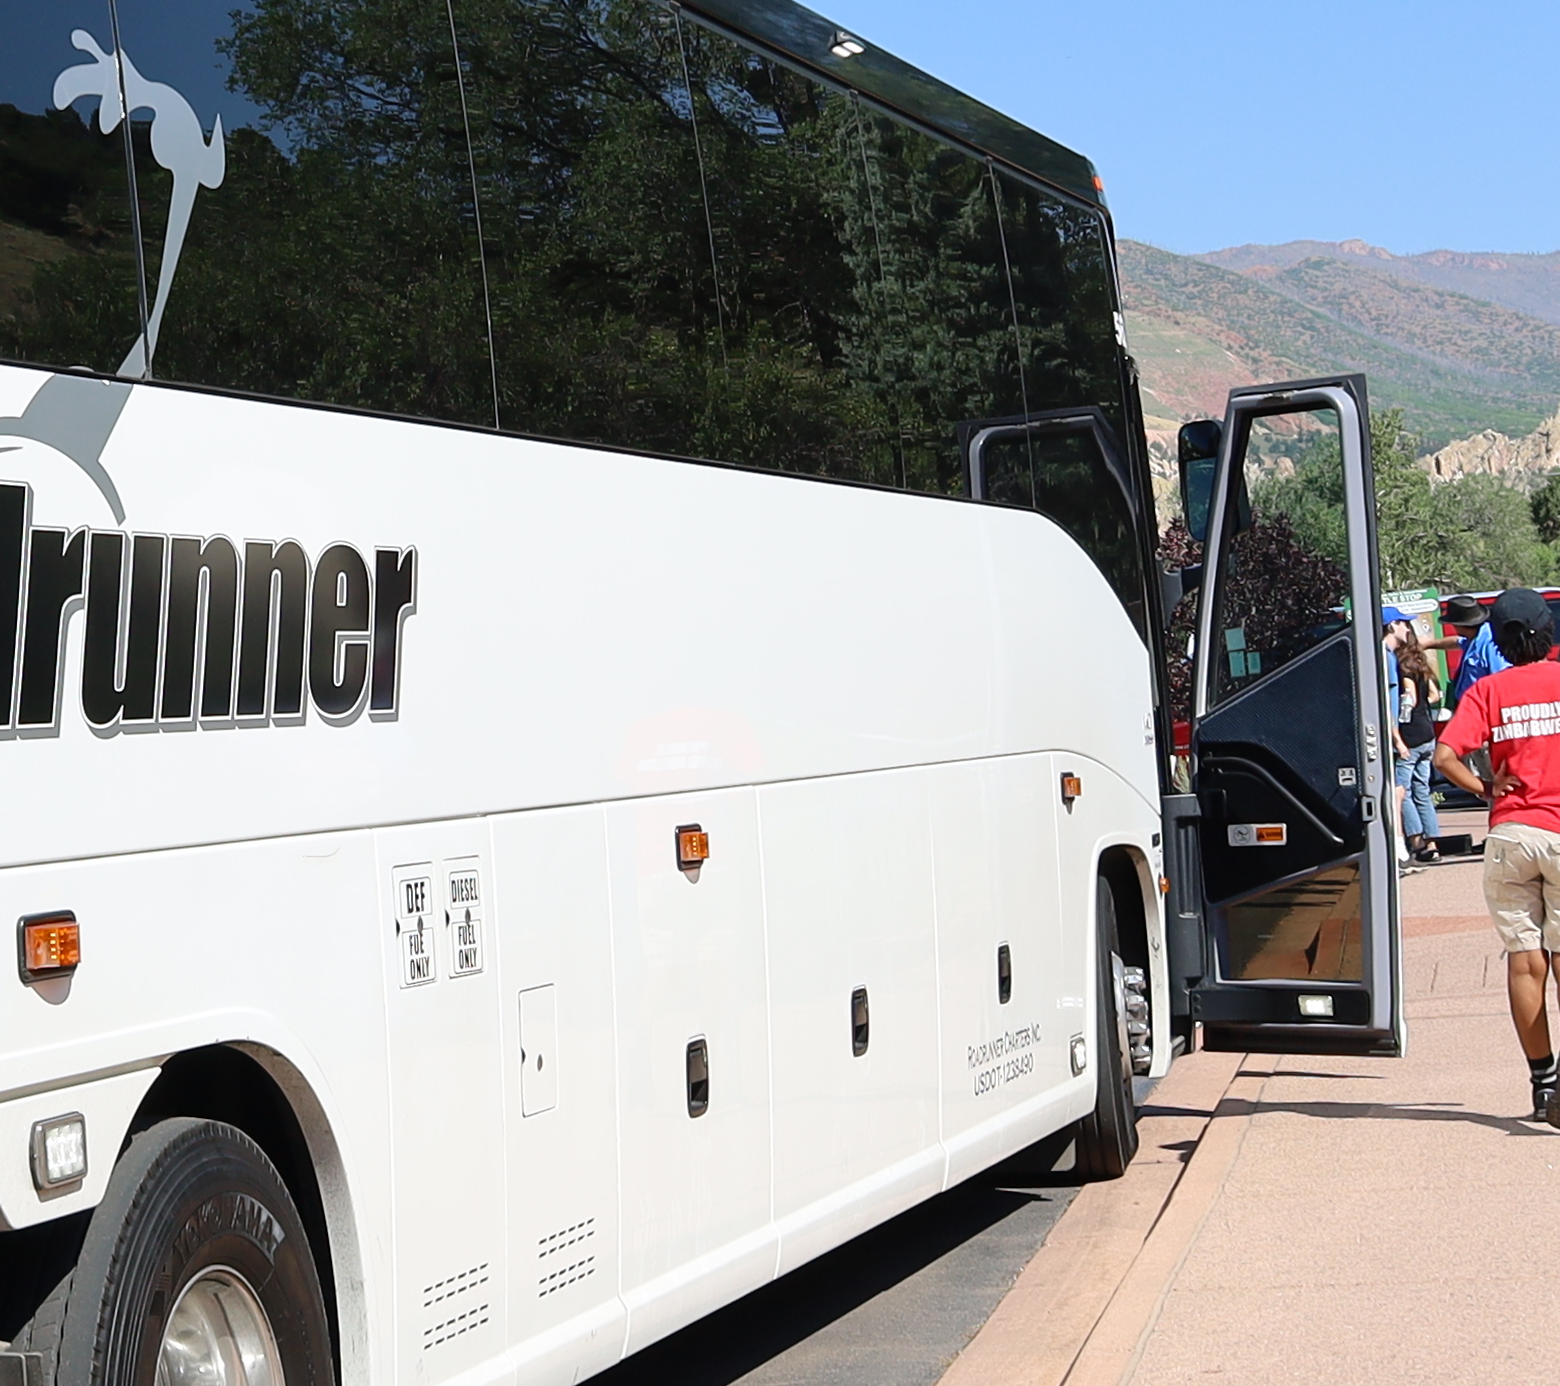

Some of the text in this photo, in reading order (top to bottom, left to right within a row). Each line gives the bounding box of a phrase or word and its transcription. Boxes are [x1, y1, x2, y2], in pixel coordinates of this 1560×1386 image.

[405, 880, 426, 914] DEF
[451, 878, 478, 903] DIESEL
[457, 923, 476, 946] FUEL
[409, 956, 430, 981] ONLY
[458, 947, 477, 970] ONLY
